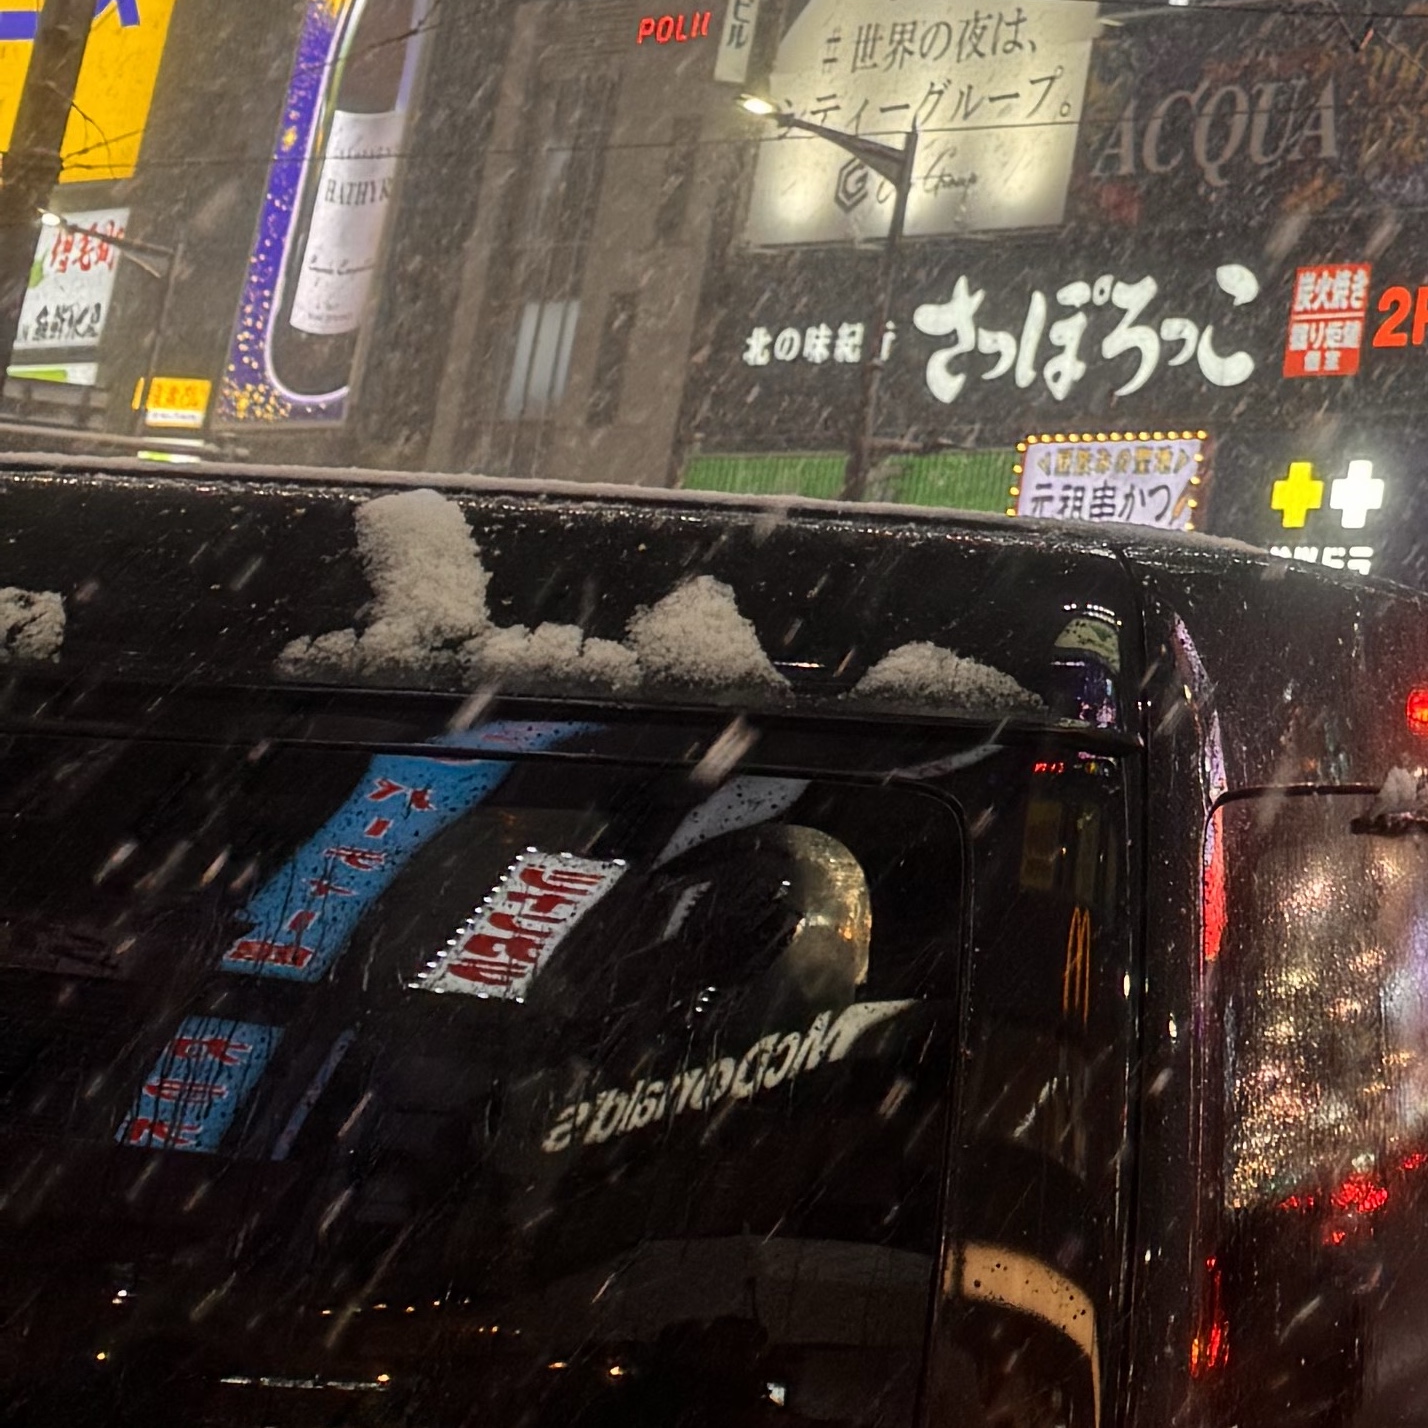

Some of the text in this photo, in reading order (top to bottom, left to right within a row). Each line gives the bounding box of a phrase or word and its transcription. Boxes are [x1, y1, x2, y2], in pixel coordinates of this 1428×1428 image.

[1090, 73, 1340, 188] ACQUA
[912, 262, 1261, 404] さっぽろっこ
